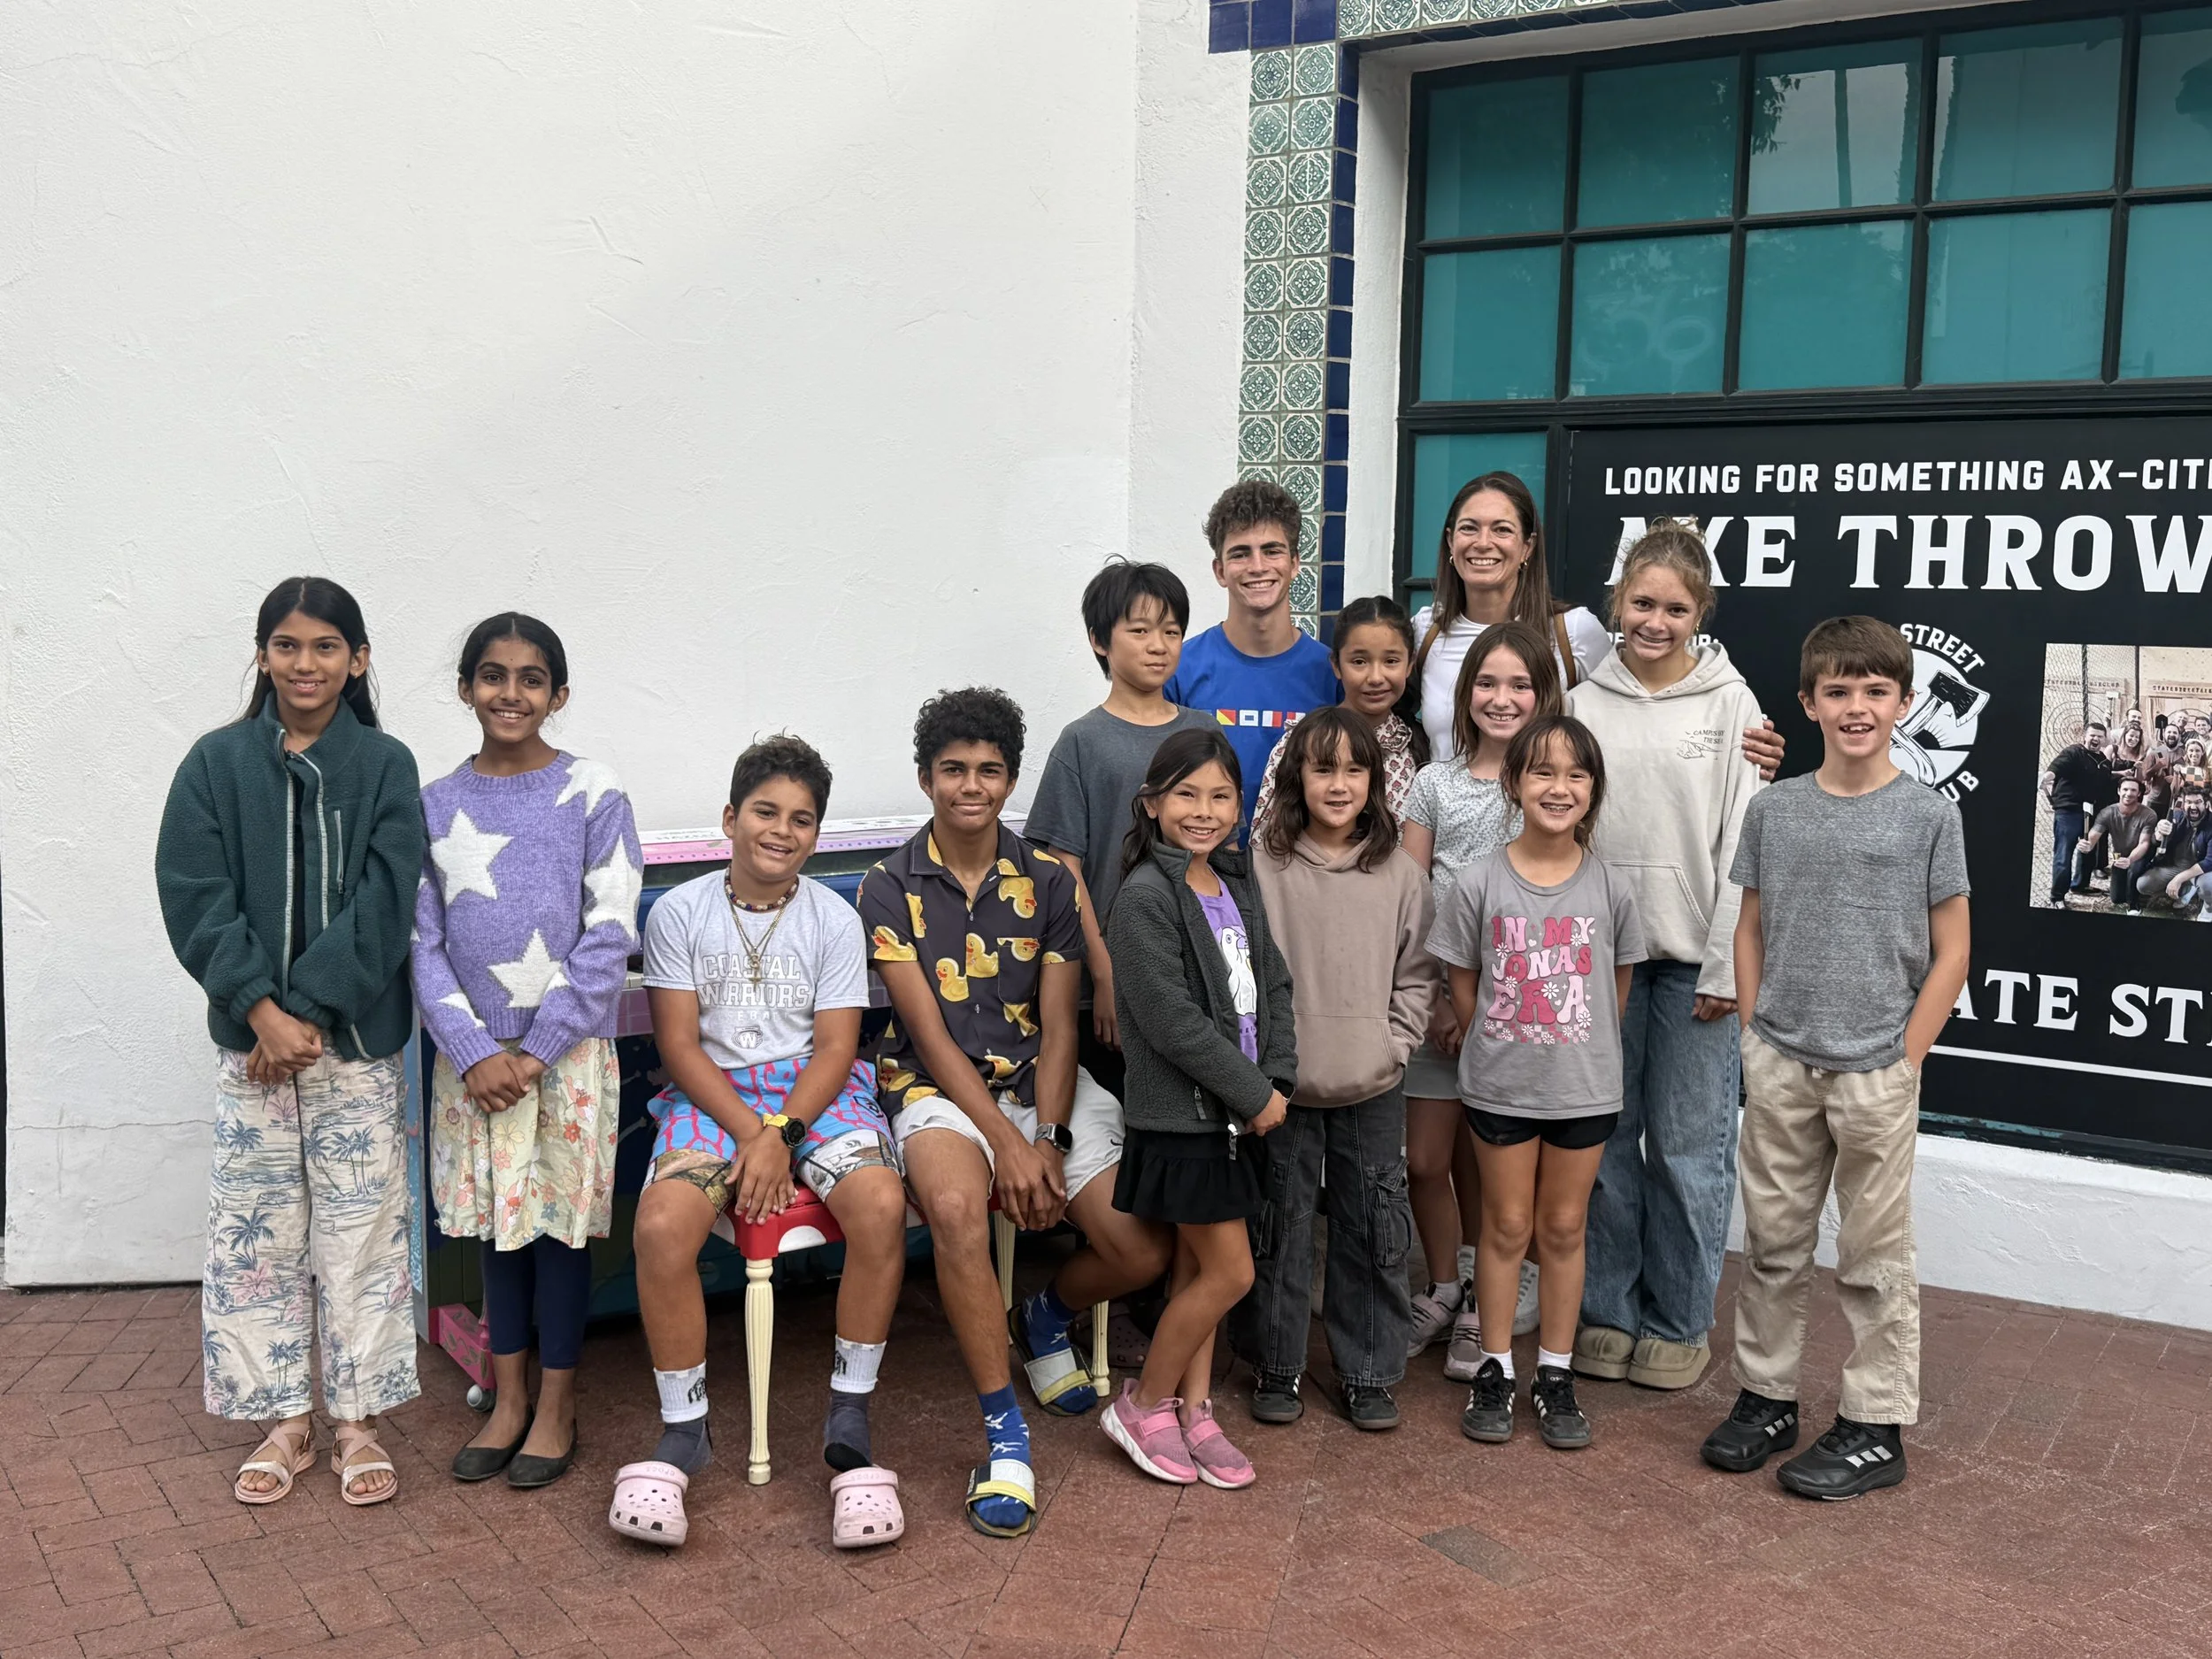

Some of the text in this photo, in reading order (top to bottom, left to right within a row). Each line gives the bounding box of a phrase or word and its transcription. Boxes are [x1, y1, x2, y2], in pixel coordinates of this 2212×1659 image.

[1604, 458, 2212, 495] LOOKING FOR SOMETHING AX-CIT
[1837, 514, 2212, 594] THROW
[1900, 622, 1985, 673] STREET
[1939, 770, 1979, 803] UB
[1491, 915, 1595, 953] IN MY
[1491, 946, 1592, 984] JONAS
[695, 981, 811, 1008] WRRIORS
[1486, 974, 1590, 1025] ERA
[1947, 969, 2212, 1048] ATE ST
